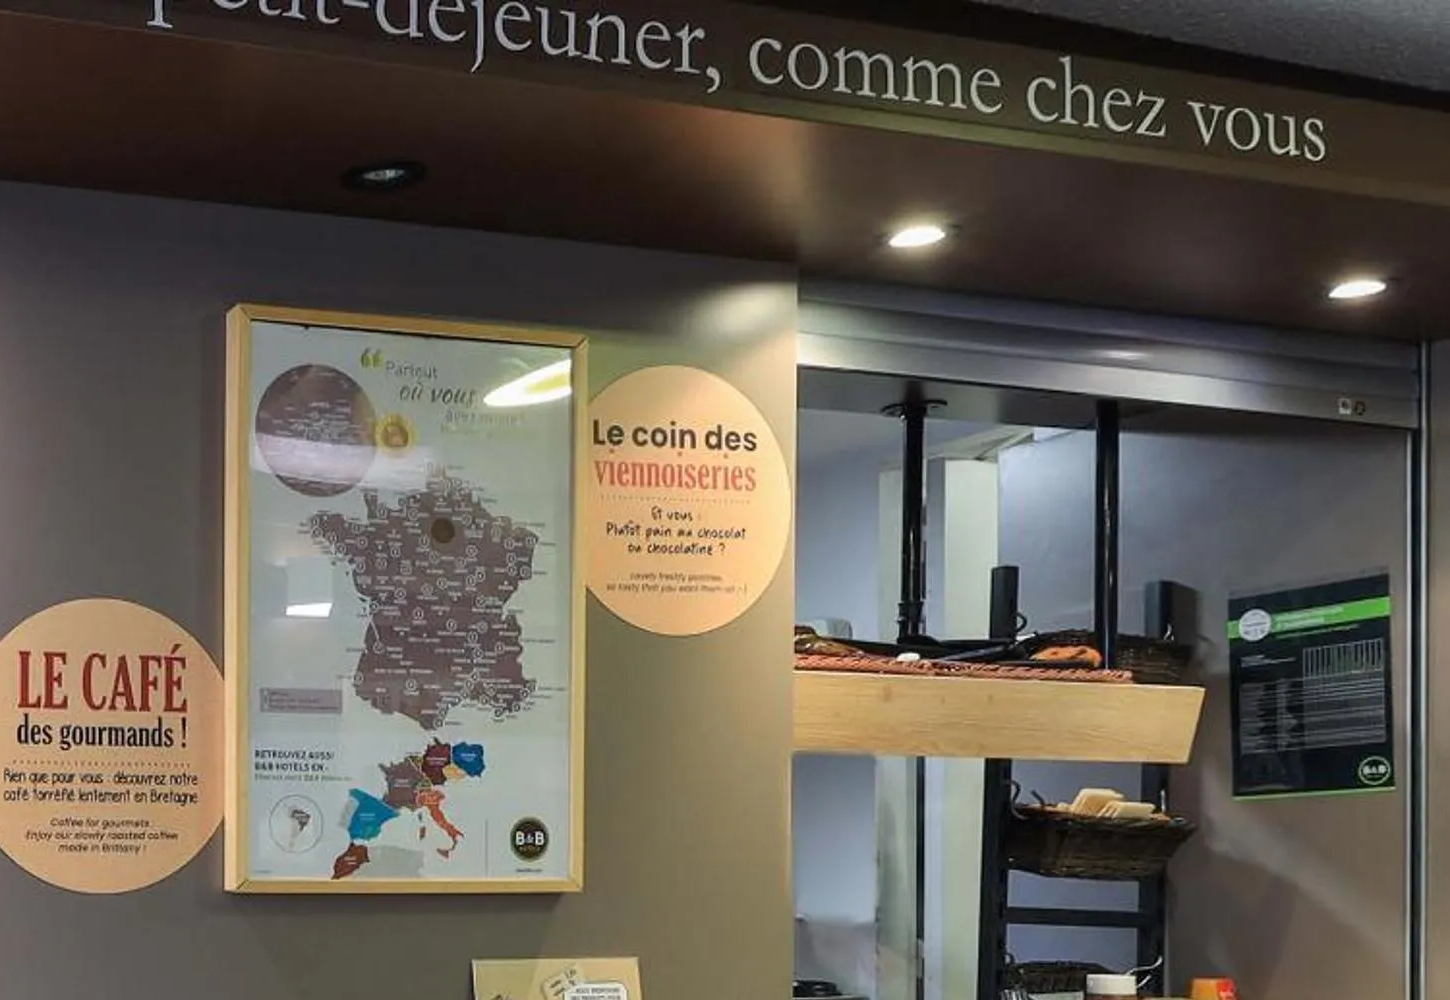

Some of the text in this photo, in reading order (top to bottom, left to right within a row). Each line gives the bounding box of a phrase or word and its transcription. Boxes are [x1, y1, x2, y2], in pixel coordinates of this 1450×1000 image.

[749, 36, 1004, 114] comme
[1026, 56, 1167, 137] chez
[1187, 100, 1327, 162] vous
[593, 419, 758, 452] Le coin des
[594, 449, 757, 492] viennoiseries
[697, 526, 746, 540] chocolat
[647, 543, 713, 555] chocolatine
[17, 643, 188, 713] LE CAFÉ
[16, 713, 187, 750] des gourmands !
[3, 768, 26, 784] Rien
[28, 772, 48, 787] que
[52, 772, 75, 787] pour
[80, 772, 104, 783] vous
[113, 770, 166, 786] découvrez
[169, 772, 198, 786] notre
[3, 787, 29, 802] café
[78, 788, 131, 803] lentement
[134, 791, 148, 804] en
[150, 789, 198, 807] Bretagne
[515, 830, 545, 846] B&B
